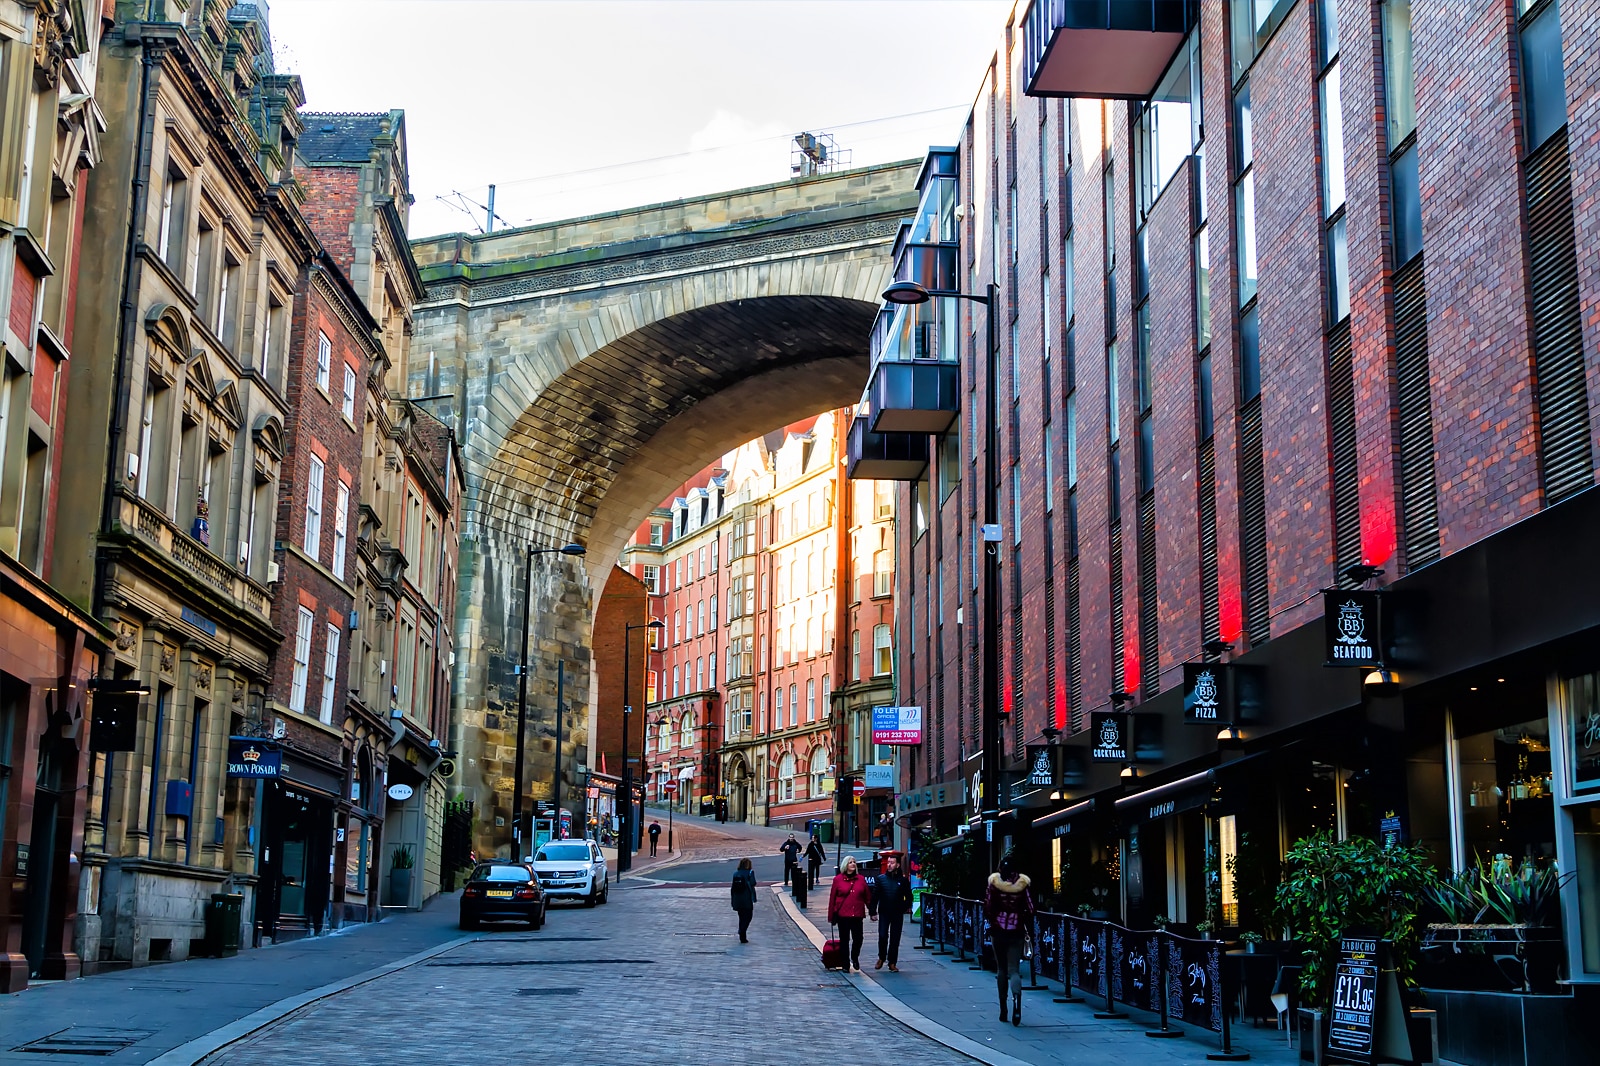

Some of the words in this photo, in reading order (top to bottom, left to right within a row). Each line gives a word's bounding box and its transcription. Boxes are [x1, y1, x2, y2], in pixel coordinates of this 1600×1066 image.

[1344, 619, 1360, 631] BB
[1334, 646, 1372, 658] SEAFOOD
[1200, 686, 1213, 696] BB
[1196, 708, 1216, 718] PIZZA
[1094, 749, 1126, 758] COCKTAILS
[226, 762, 250, 774] CROWN
[250, 764, 276, 774] POSADA
[1032, 776, 1052, 784] STEAKS
[1341, 941, 1376, 952] BABUCHO
[1335, 976, 1374, 1012] £13.95
